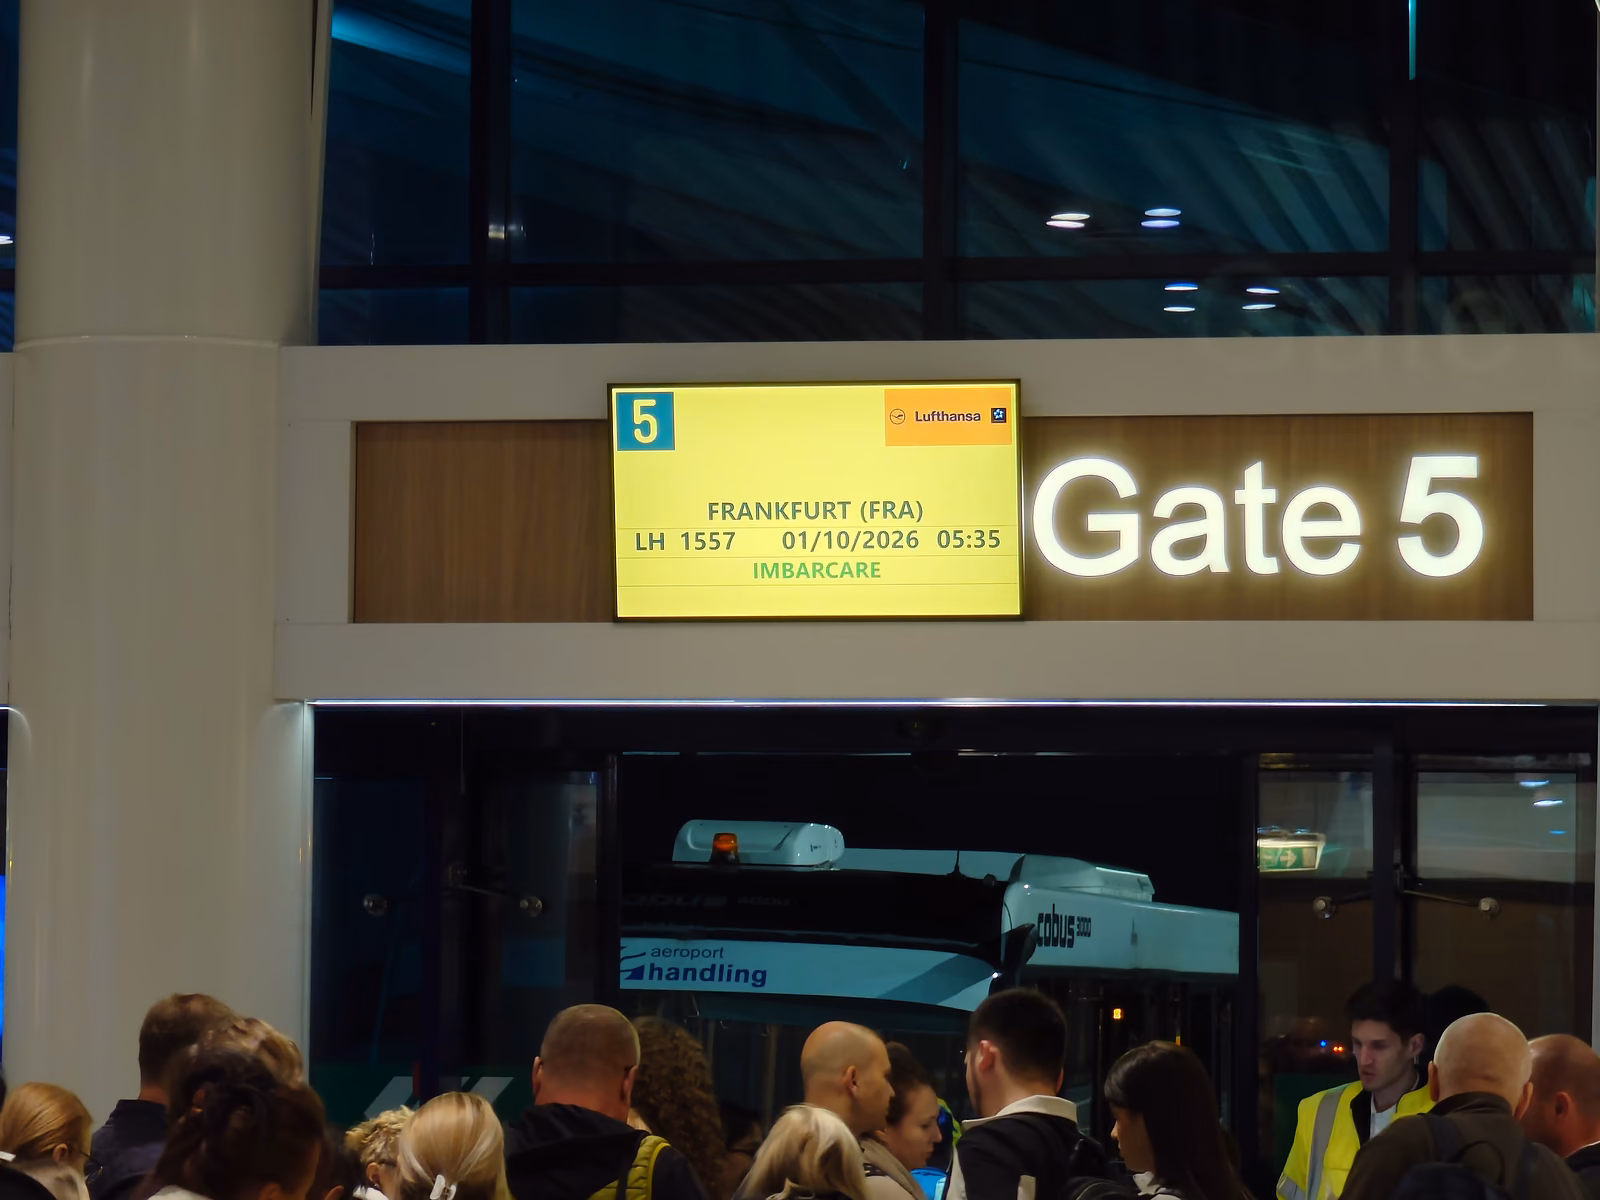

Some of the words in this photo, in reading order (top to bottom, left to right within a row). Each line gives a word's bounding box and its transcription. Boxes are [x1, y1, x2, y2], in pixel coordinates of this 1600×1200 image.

[632, 398, 659, 445] 5
[915, 410, 981, 423] Lufthansa
[708, 500, 851, 521] FRANKFURT
[860, 499, 924, 523] (FRA)
[1032, 456, 1363, 578] Gate
[1397, 455, 1485, 578] 5
[635, 532, 665, 551] LH
[680, 531, 736, 551] 1557
[782, 529, 920, 553] 01/10/2026
[937, 529, 1001, 550] 05:35
[753, 561, 882, 580] IMBARCARE
[1037, 902, 1075, 949] cobus
[1076, 915, 1092, 938] 3000
[650, 946, 724, 961] aeroport
[648, 962, 768, 988] handling
